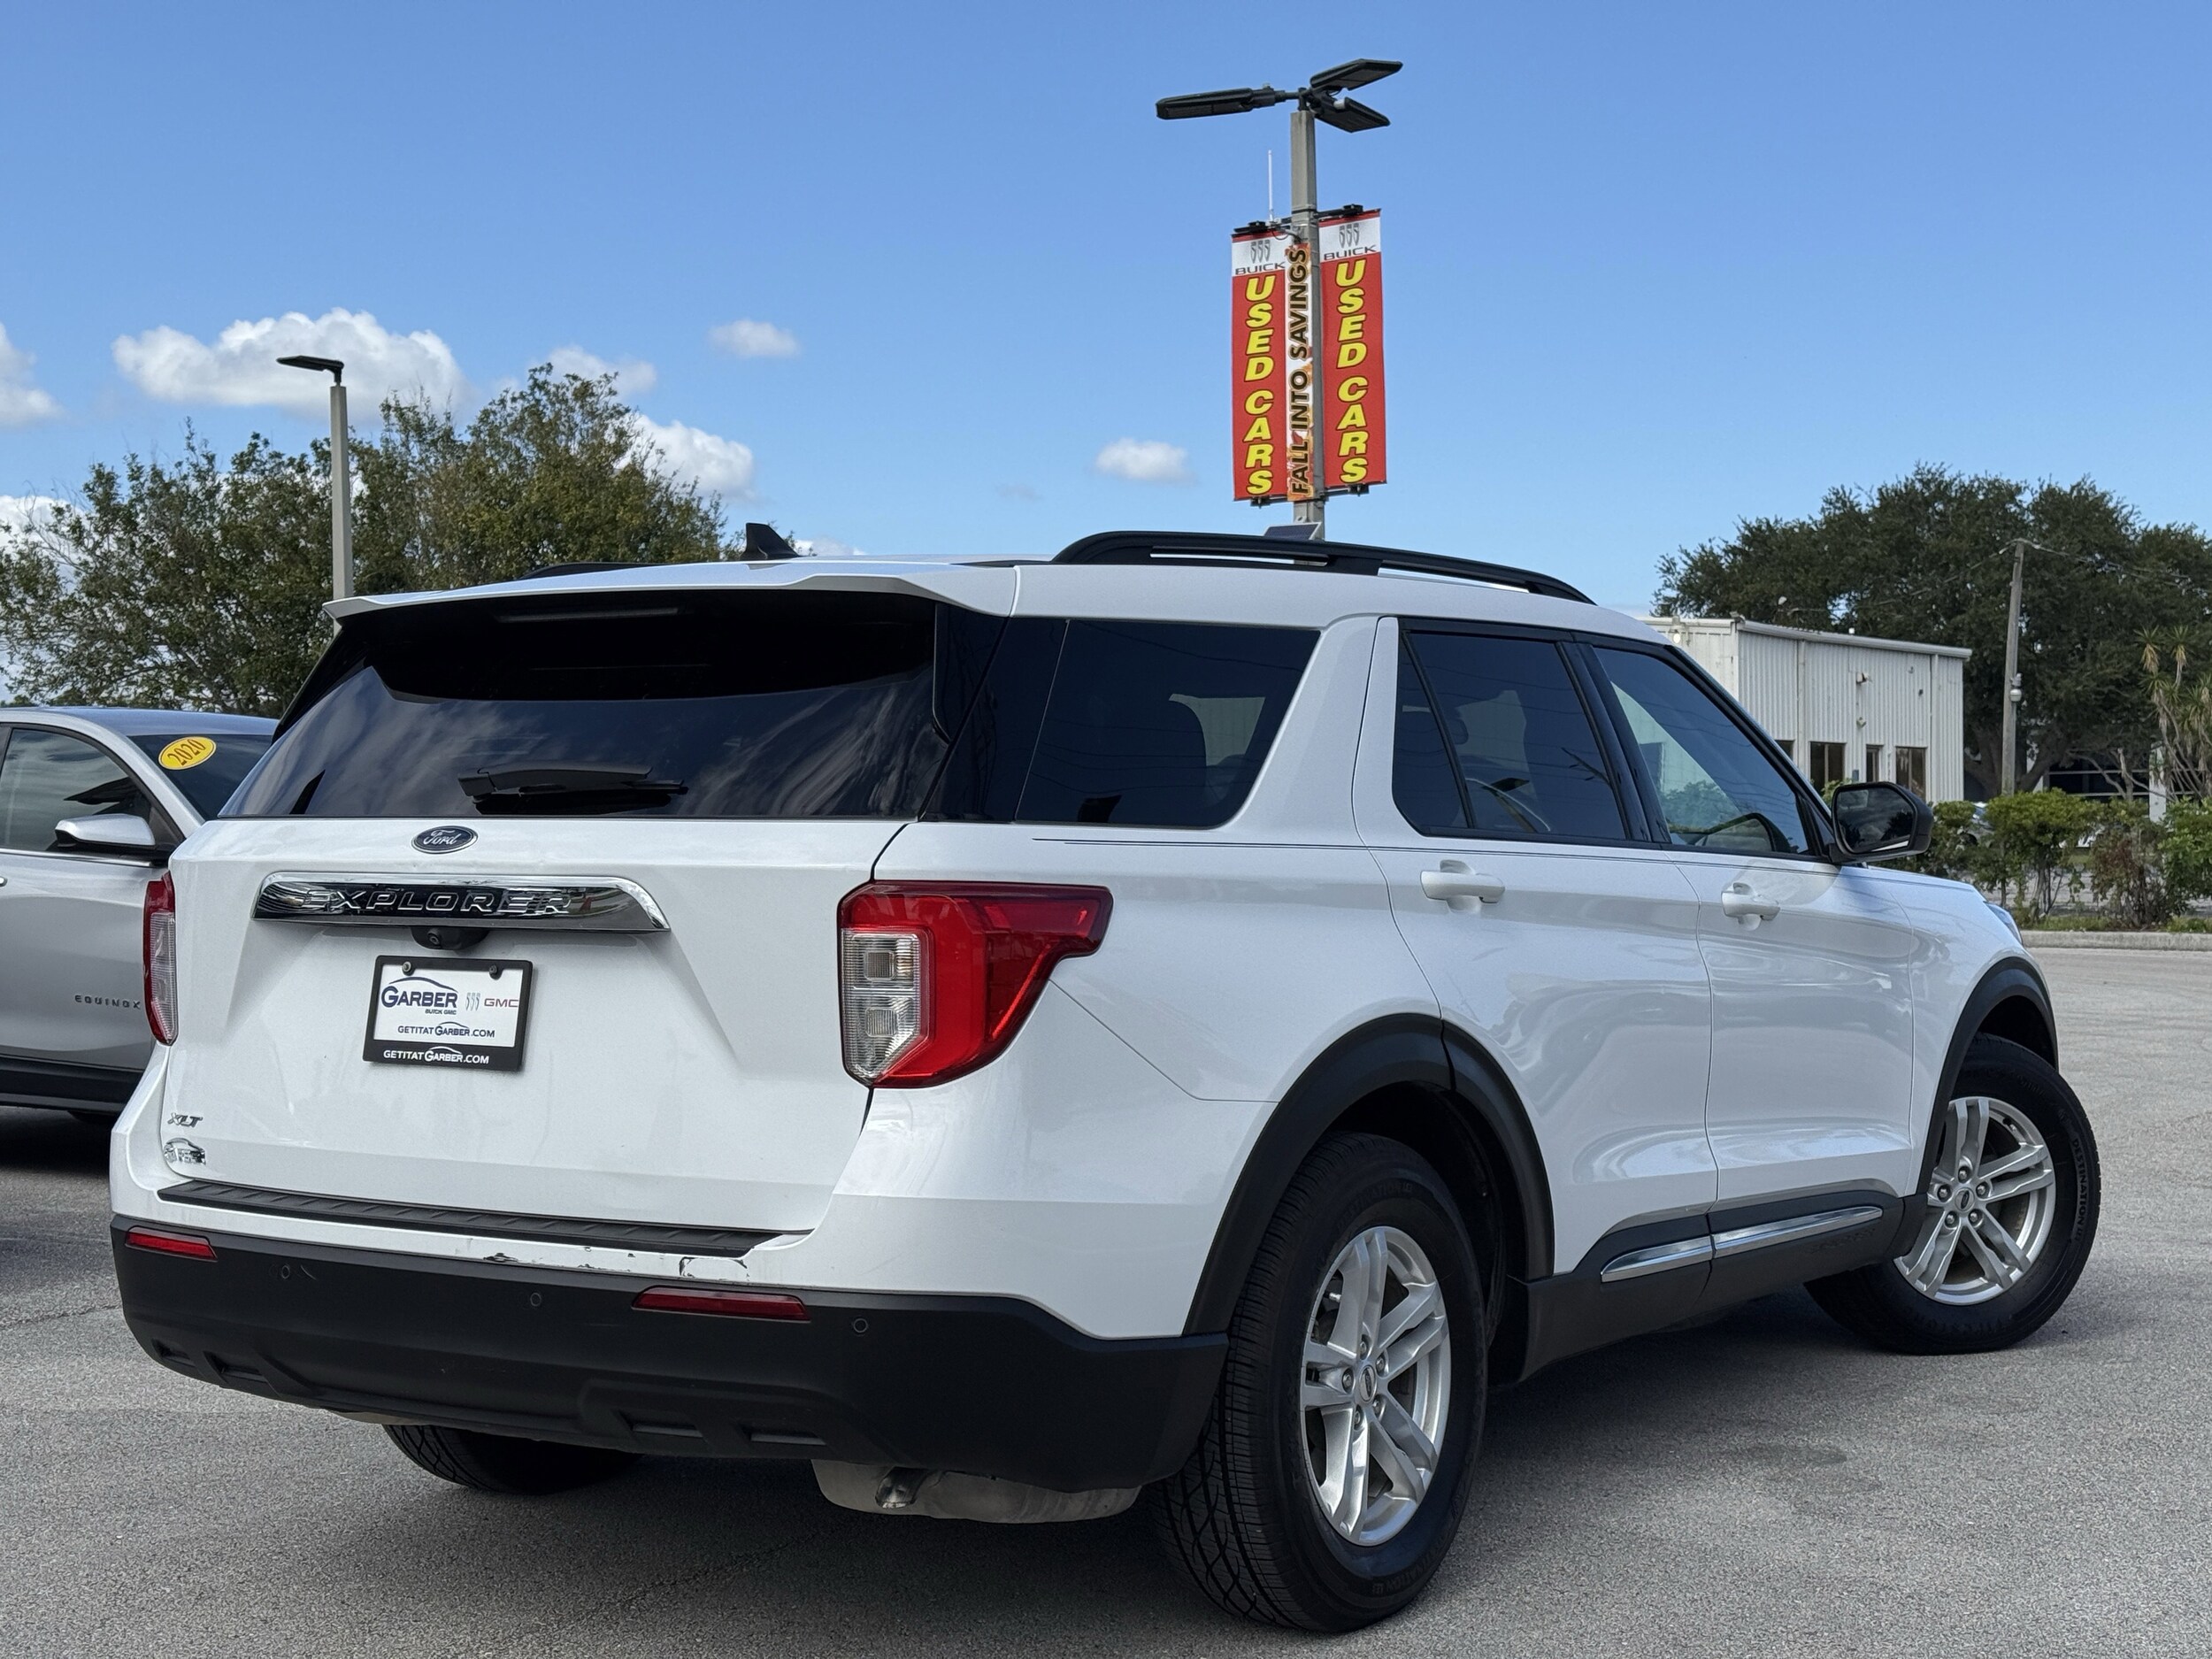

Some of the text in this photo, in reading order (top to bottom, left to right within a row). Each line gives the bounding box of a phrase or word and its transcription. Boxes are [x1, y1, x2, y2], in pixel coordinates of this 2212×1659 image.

[1324, 244, 1377, 261] BUICK
[1235, 261, 1286, 275] BUICK
[1287, 247, 1310, 496] FALL INTO SAVINGS
[1335, 258, 1370, 484] USED CARS
[1243, 275, 1276, 495] USED CARS
[167, 739, 206, 766] 2020
[423, 830, 462, 845] Ford
[302, 888, 572, 915] EXPLORER
[74, 995, 141, 1010] EQUINOX
[381, 985, 458, 1009] GARBER
[484, 998, 519, 1008] GMC
[167, 1112, 204, 1128] XLT
